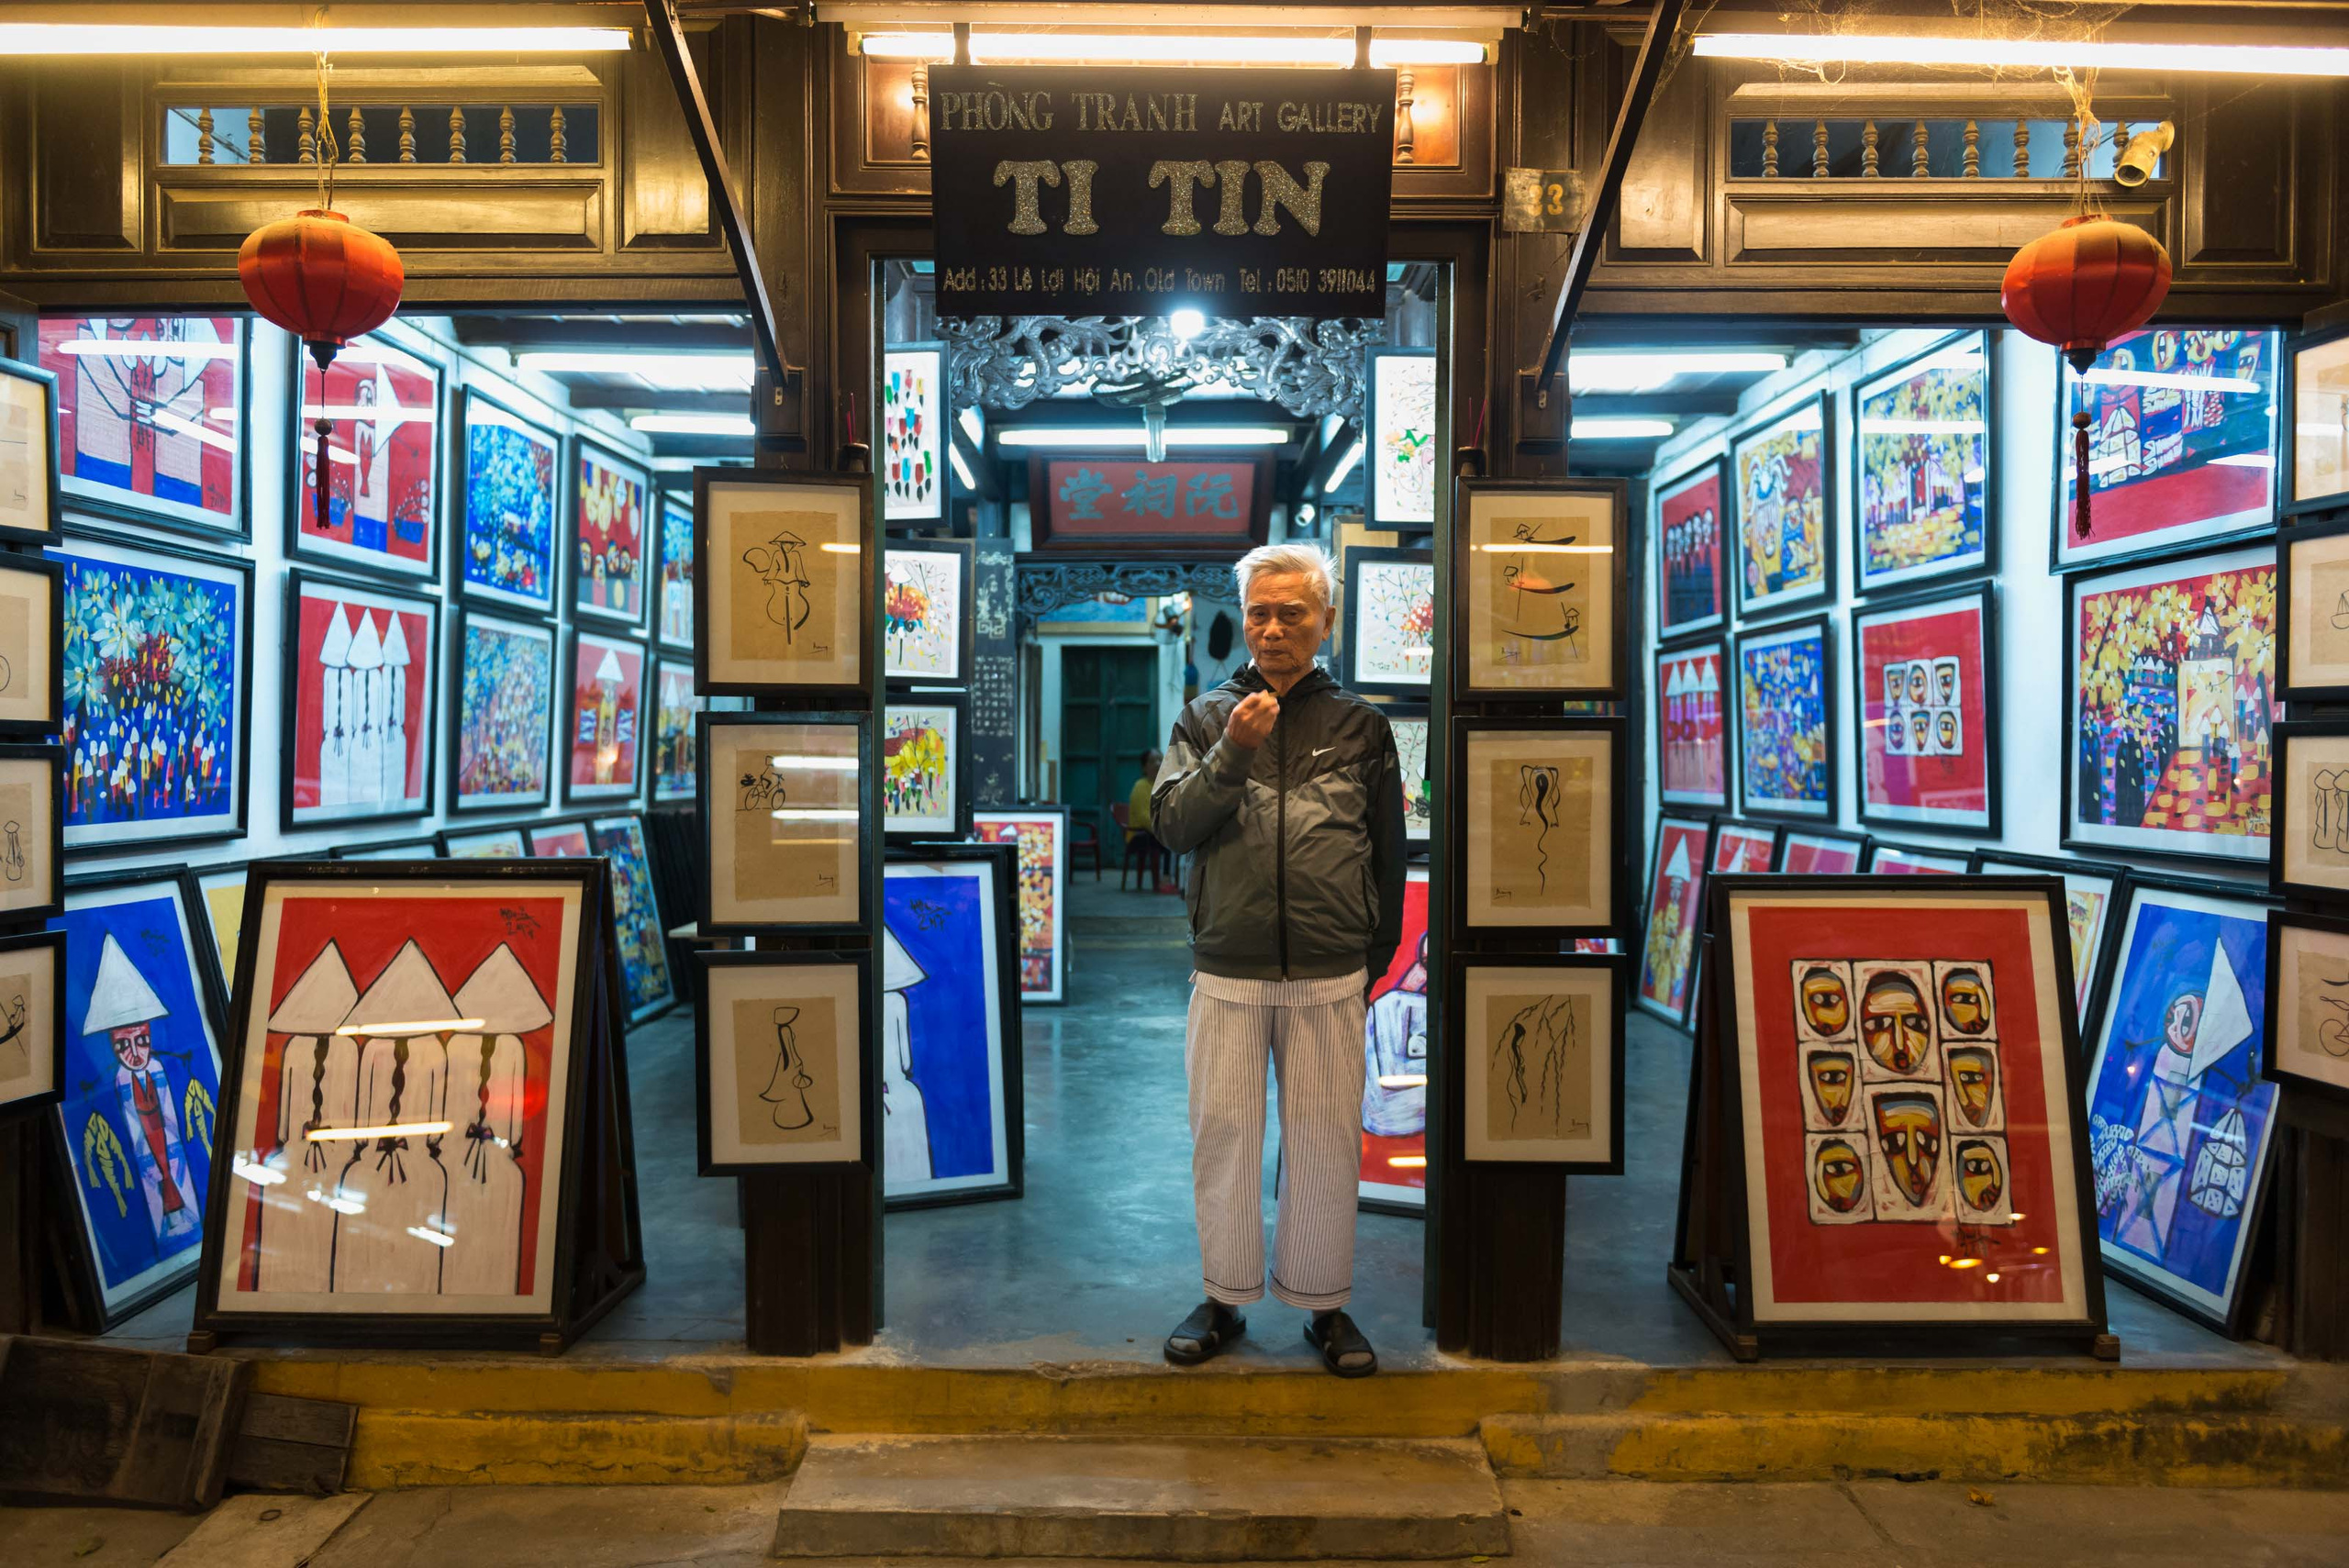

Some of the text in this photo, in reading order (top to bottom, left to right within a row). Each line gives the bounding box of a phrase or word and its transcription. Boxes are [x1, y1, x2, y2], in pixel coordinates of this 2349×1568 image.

[941, 80, 1382, 134] PHÒNG TRANH ART GALLERY
[993, 159, 1330, 238] TI TIN
[1185, 267, 1226, 293] Town
[1276, 268, 1309, 293] 0510
